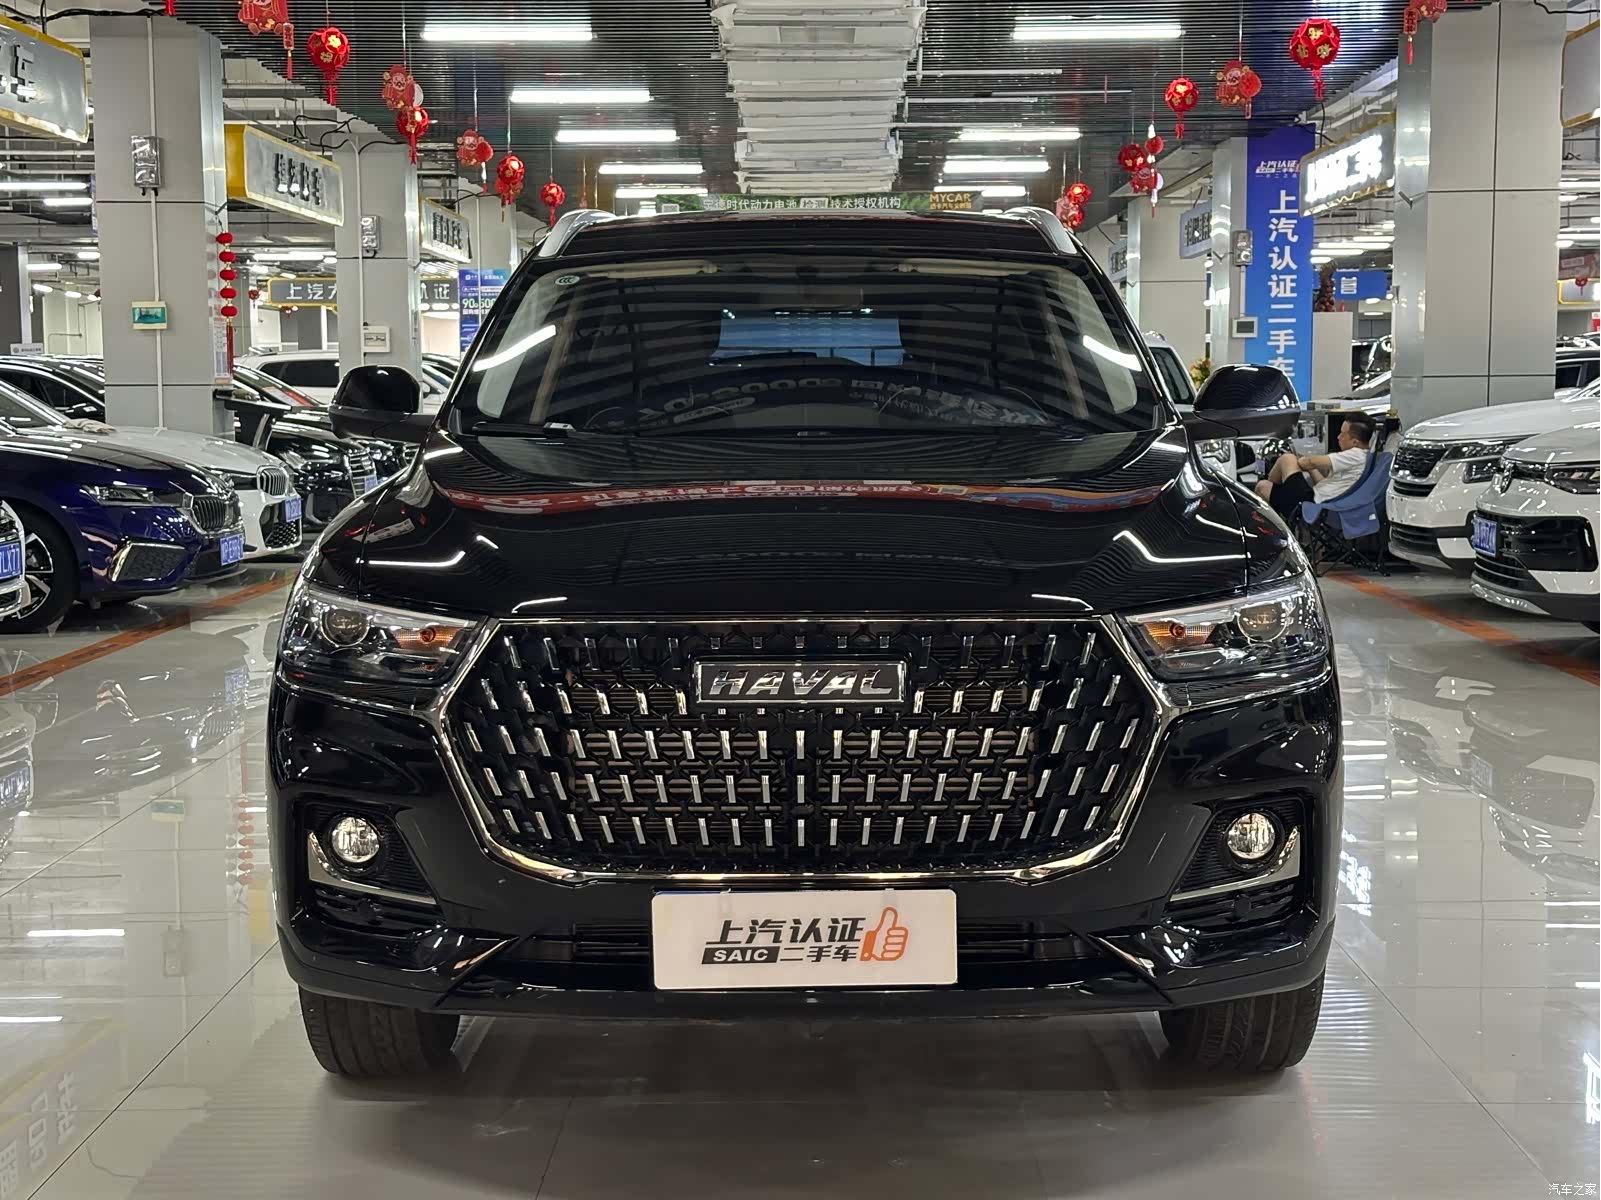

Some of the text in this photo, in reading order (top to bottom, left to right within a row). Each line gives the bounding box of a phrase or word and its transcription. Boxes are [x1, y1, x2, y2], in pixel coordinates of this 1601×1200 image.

[929, 193, 972, 202] MYCAR
[709, 669, 893, 695] HAVAL
[706, 917, 866, 945] 上汽认证
[713, 945, 859, 963] SAIC 二手车
